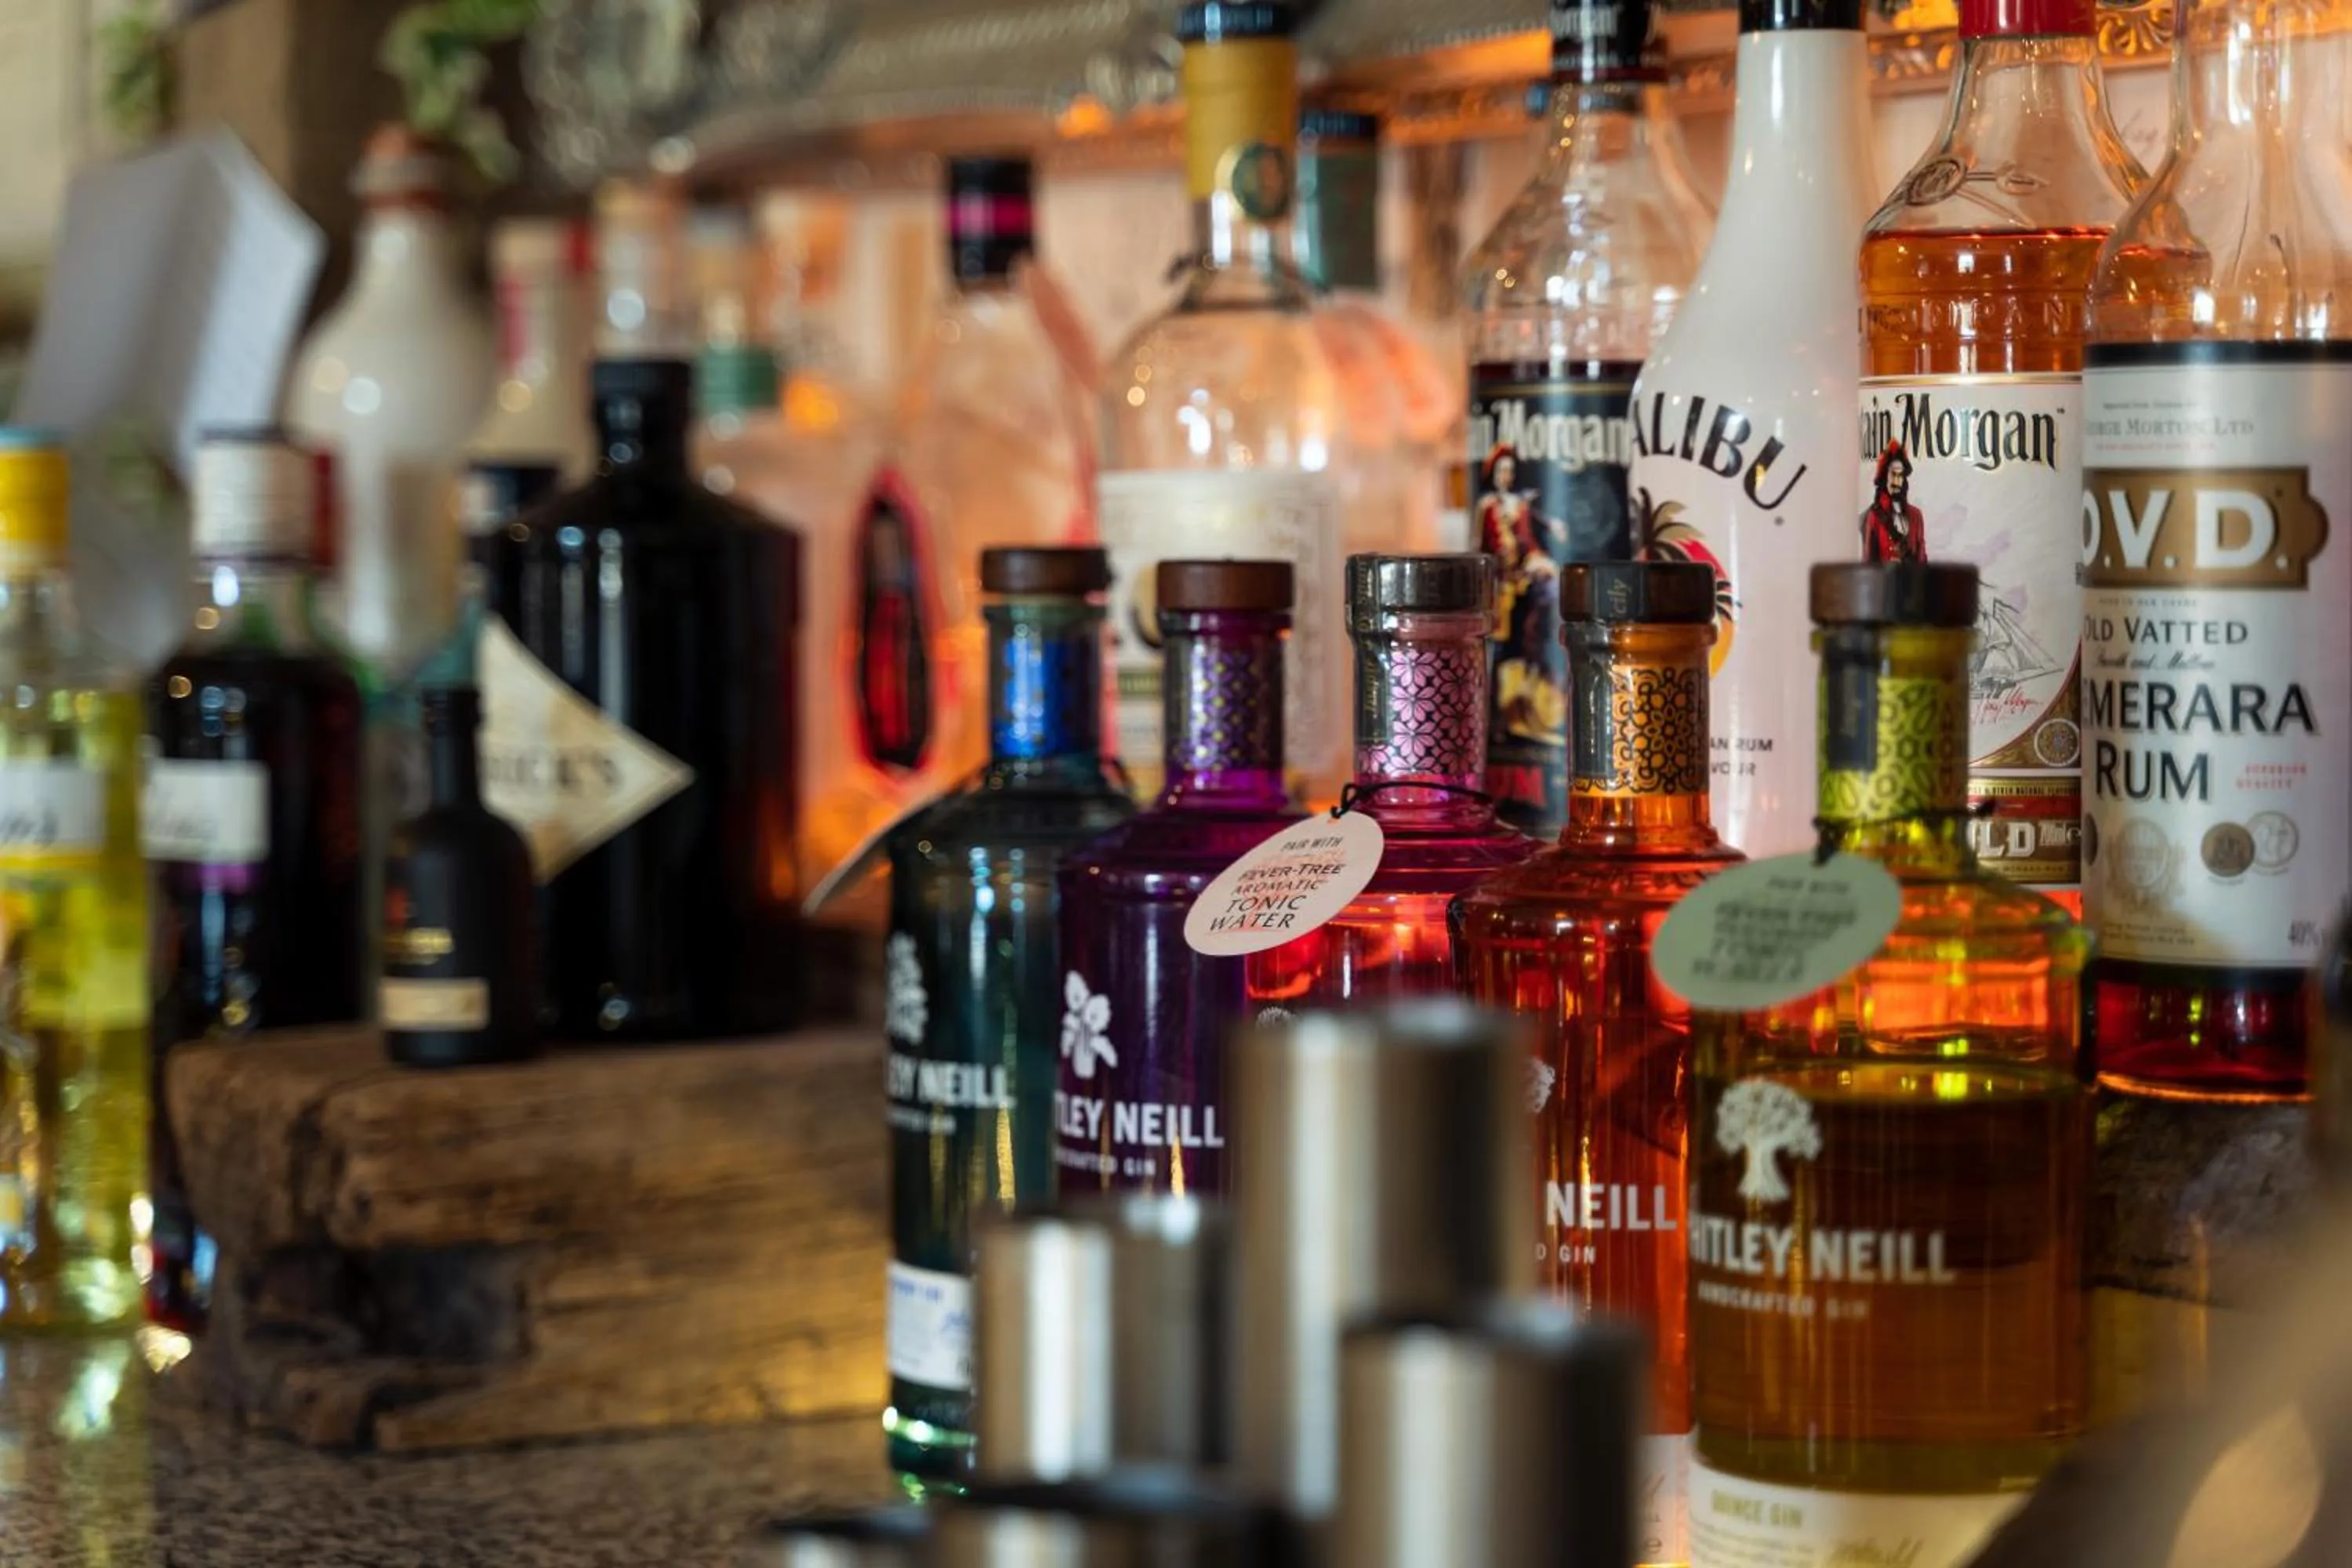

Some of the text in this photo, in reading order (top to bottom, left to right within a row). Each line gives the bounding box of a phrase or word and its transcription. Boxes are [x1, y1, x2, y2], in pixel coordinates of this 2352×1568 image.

[1491, 400, 1634, 474] Morgan
[2124, 615, 2249, 644] VATTED
[2096, 739, 2209, 802] RUM
[1280, 837, 1343, 852] PAIR WITH
[1237, 863, 1346, 883] FEVER-TREE
[1230, 879, 1329, 897] AROMATIC
[1225, 895, 1307, 913] TONIC
[1209, 913, 1296, 931] WATER
[918, 1060, 1018, 1109] NEILL
[1112, 1101, 1225, 1148] NEILL
[1546, 1179, 1678, 1231] NEILL
[1559, 1244, 1597, 1265] GIN
[1809, 1227, 1958, 1287] NEILL
